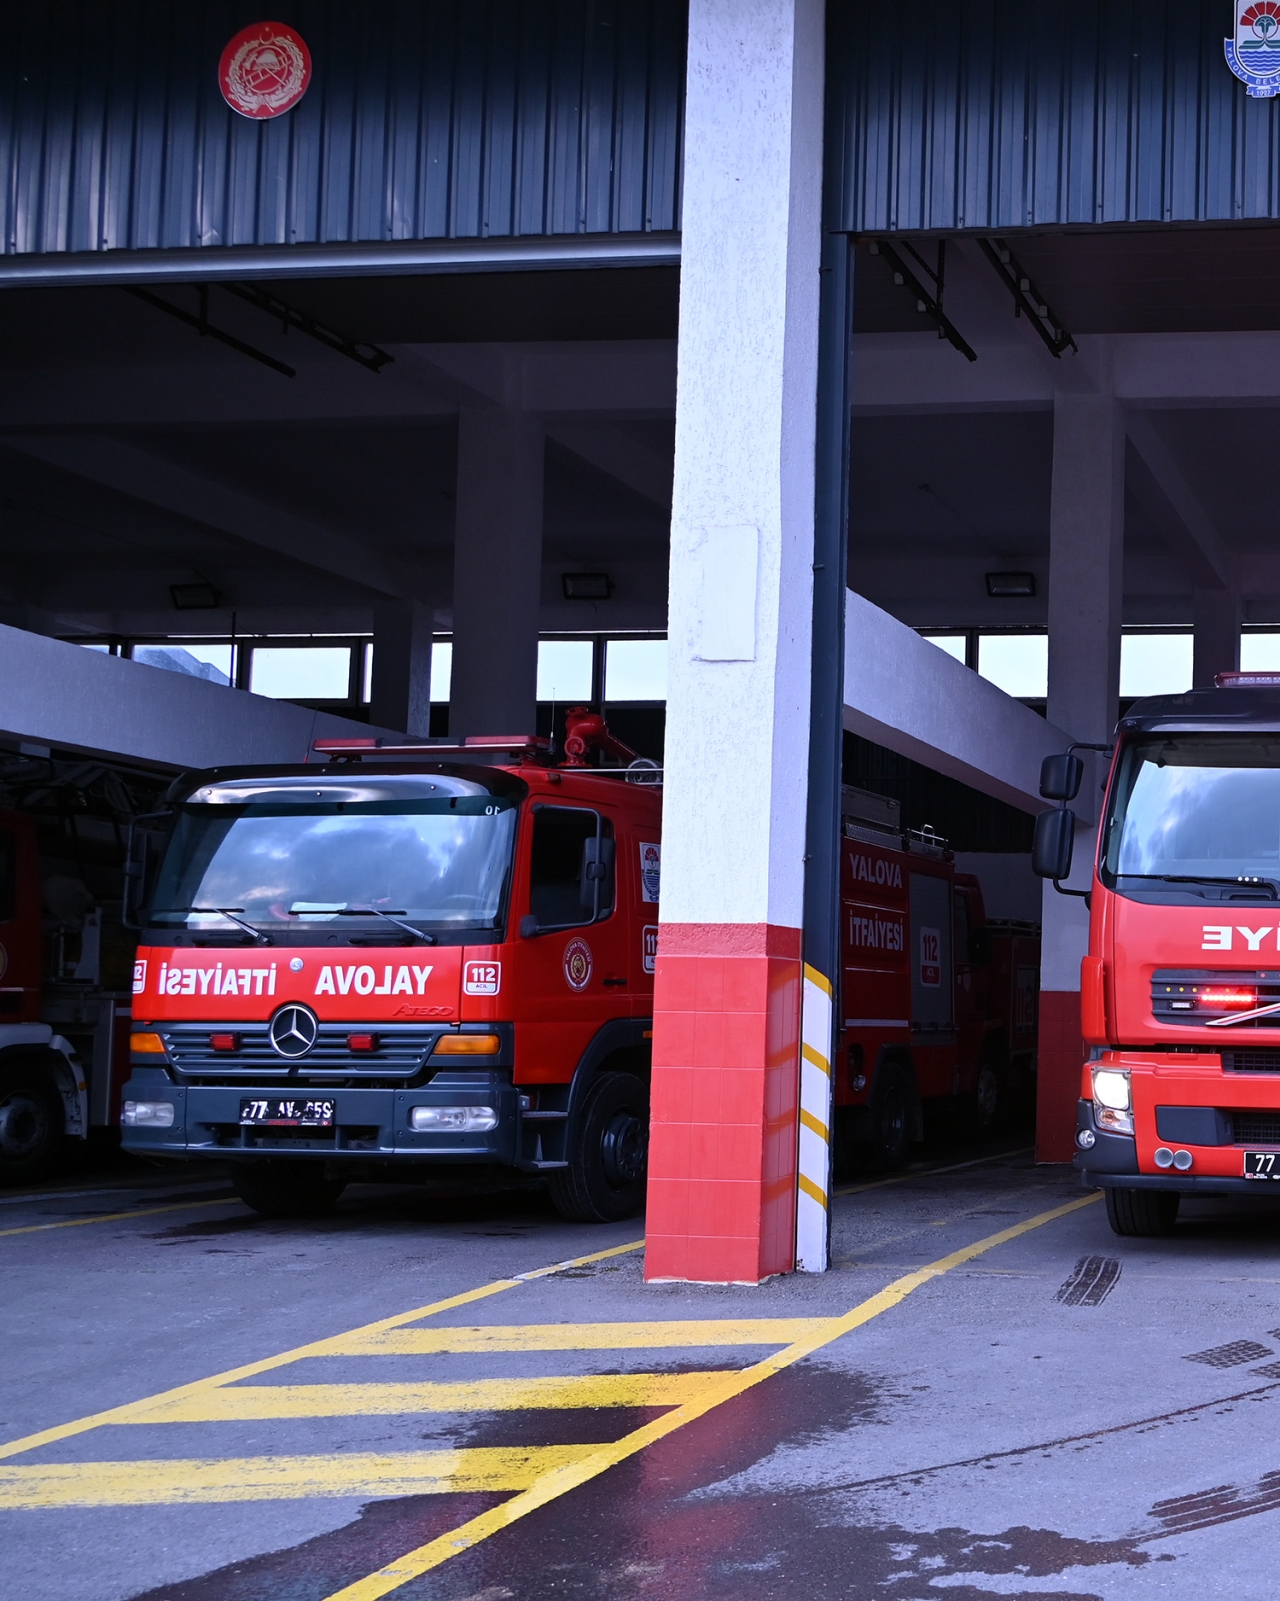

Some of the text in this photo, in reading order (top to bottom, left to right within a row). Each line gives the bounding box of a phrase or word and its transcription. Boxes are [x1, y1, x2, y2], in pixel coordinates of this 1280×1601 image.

[1226, 46, 1248, 81] YALOVA
[1256, 89, 1272, 97] 1927
[848, 852, 903, 889] YALOVA
[849, 909, 904, 952] İTFAİYESİ
[922, 934, 938, 962] 112
[471, 967, 496, 982] 112
[250, 1101, 268, 1119] 77
[1255, 1154, 1275, 1173] 77
